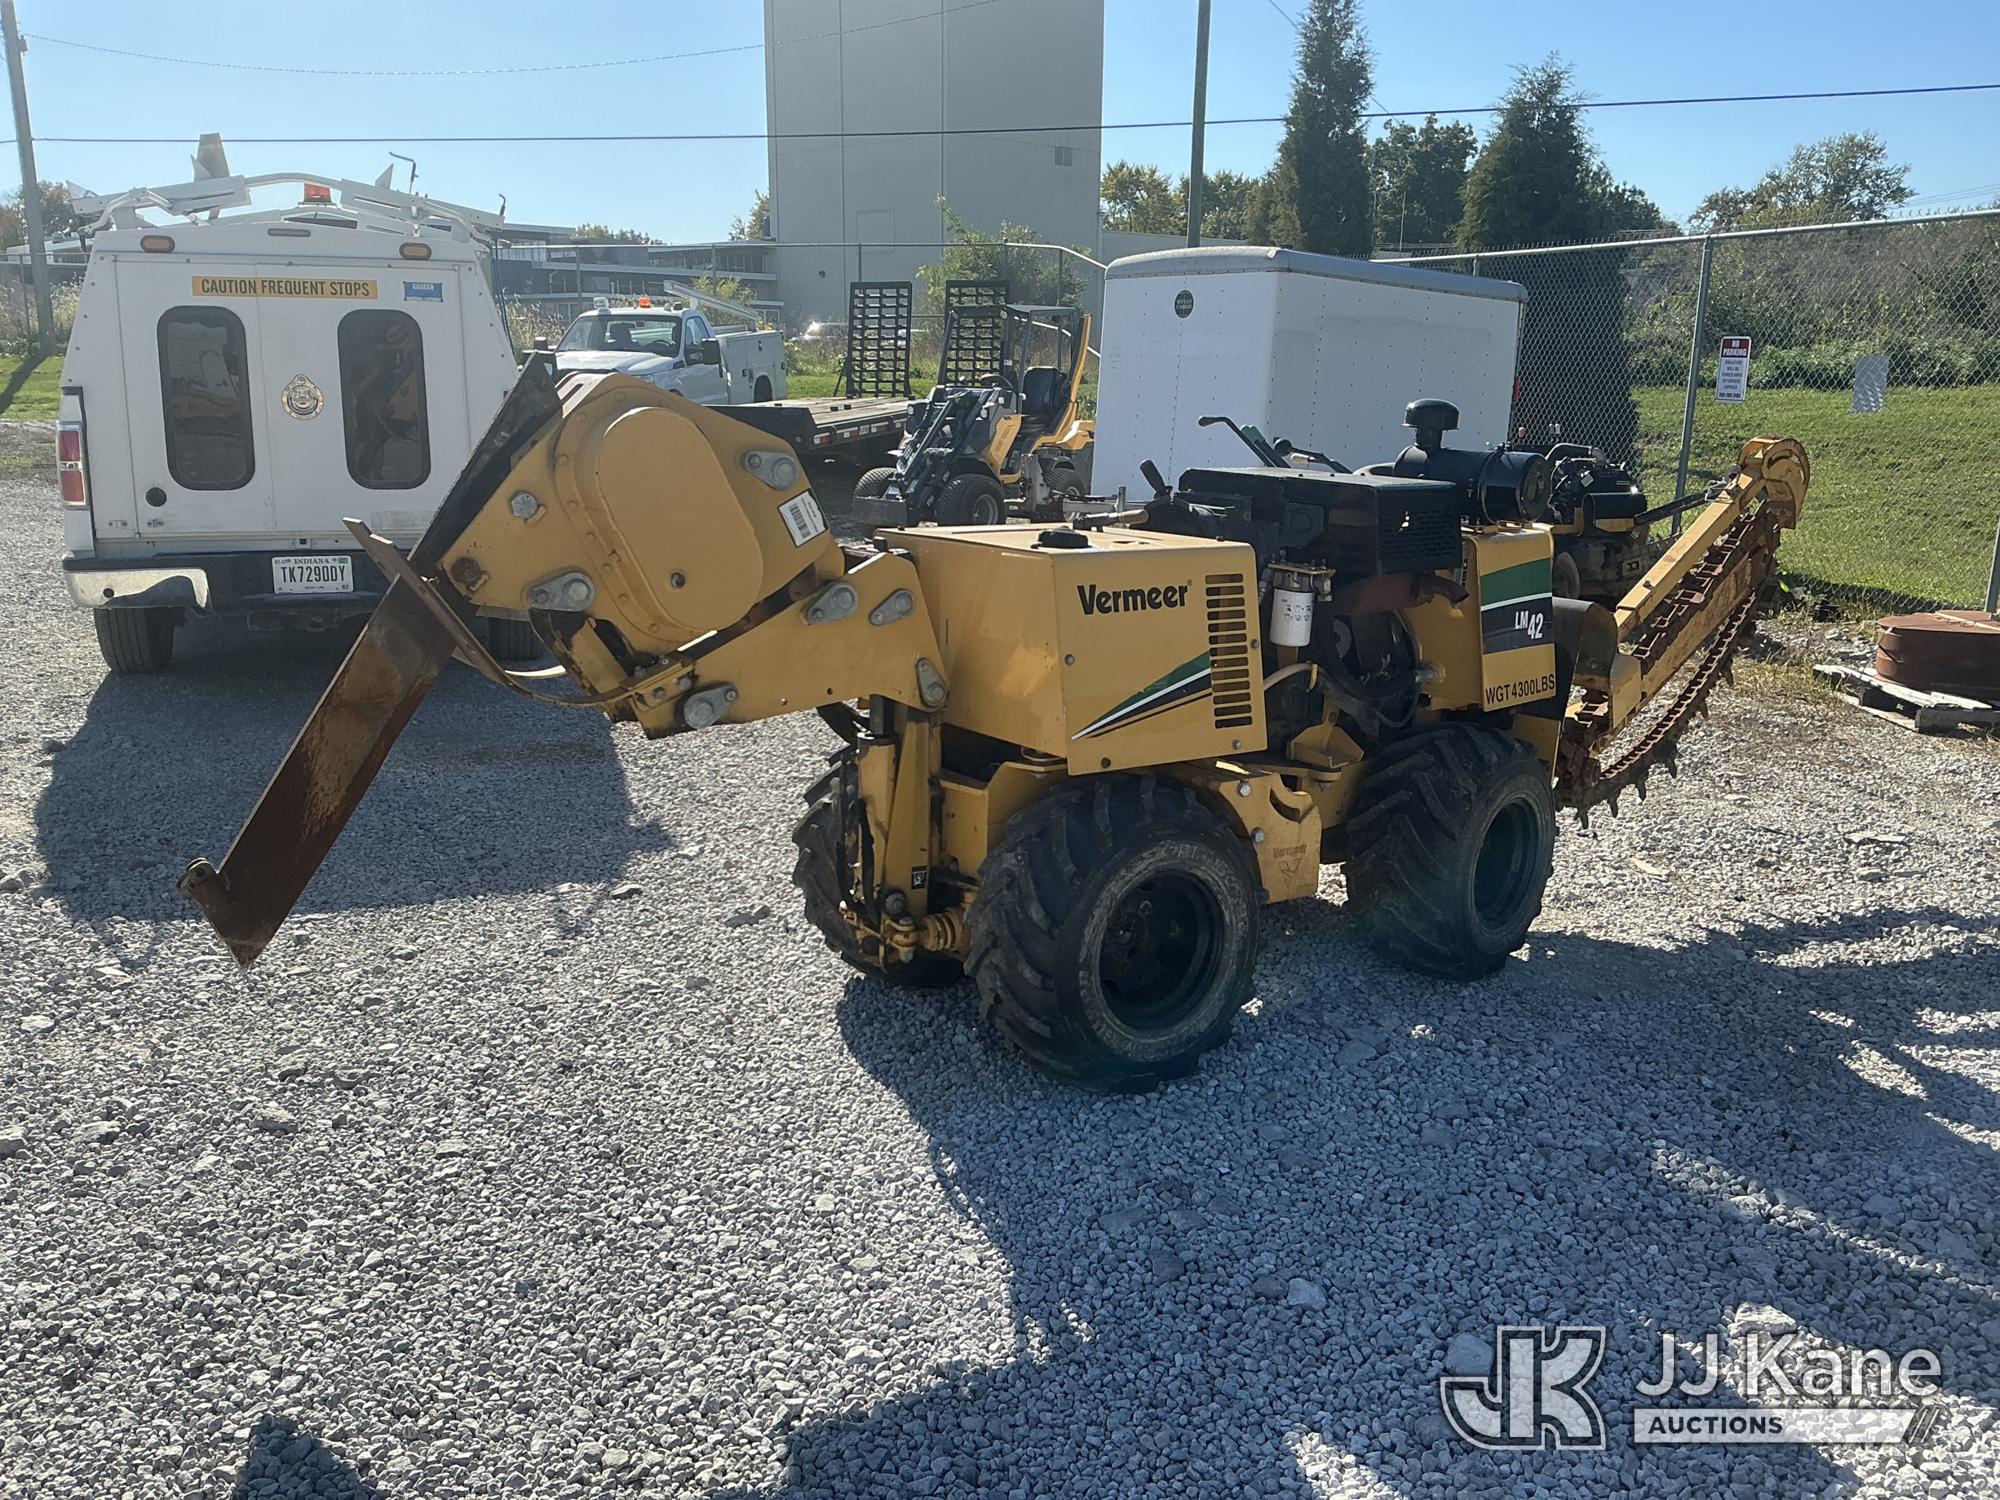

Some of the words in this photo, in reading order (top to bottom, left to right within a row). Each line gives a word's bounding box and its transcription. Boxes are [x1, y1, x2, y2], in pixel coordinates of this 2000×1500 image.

[201, 278, 257, 295] CAUTION
[261, 279, 325, 296] FREQUENT
[330, 281, 369, 297] STOPS
[1731, 340, 1740, 348] NO
[1723, 348, 1747, 356] PARKING
[1077, 584, 1188, 615] Vermeer
